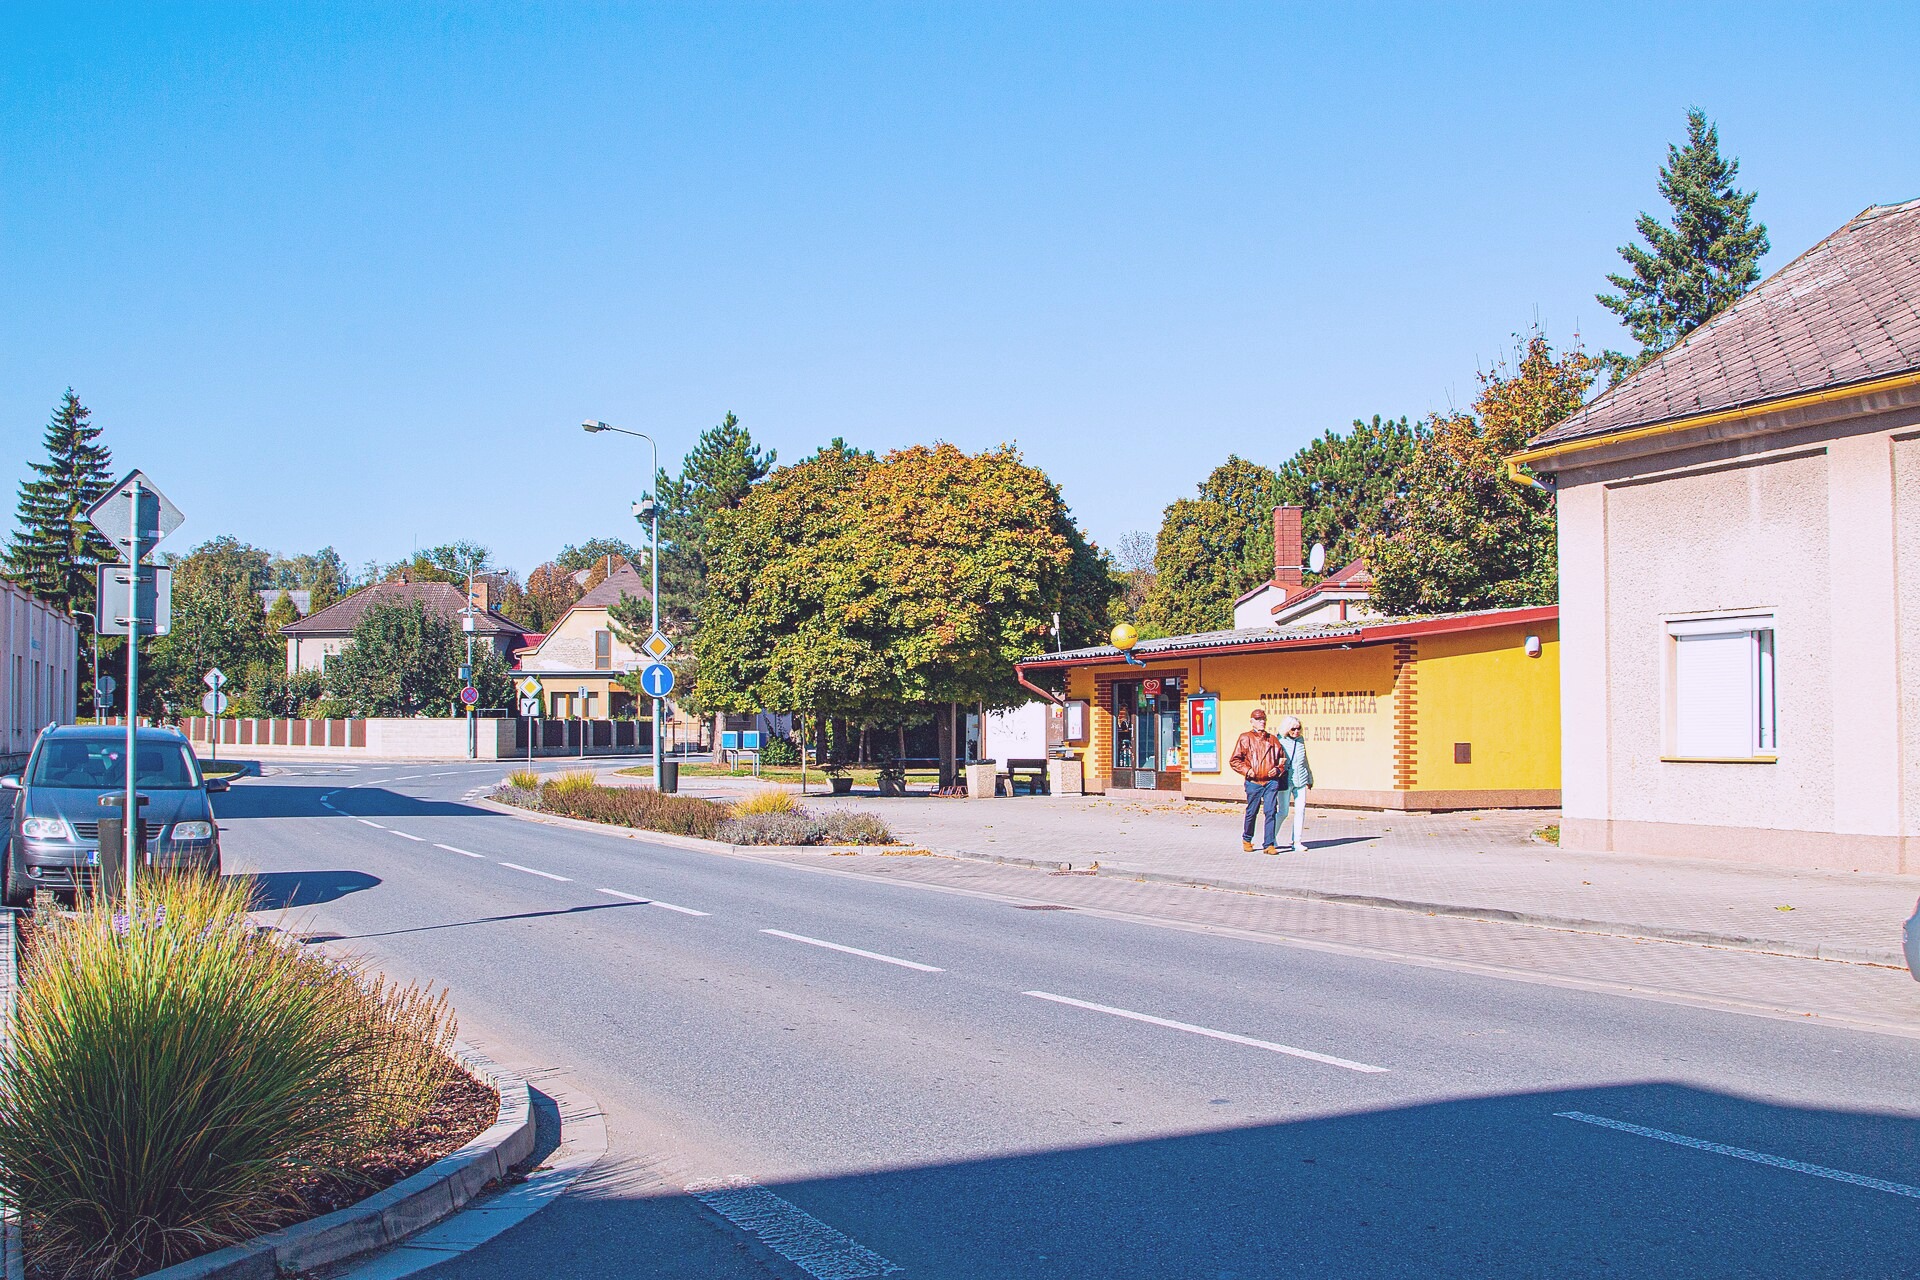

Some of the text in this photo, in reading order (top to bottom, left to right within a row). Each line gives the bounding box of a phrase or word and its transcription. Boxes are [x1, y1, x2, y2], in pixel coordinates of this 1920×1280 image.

[1322, 690, 1377, 714] TRAFIKA
[1313, 726, 1331, 742] AND
[1335, 726, 1365, 742] COFFEE
